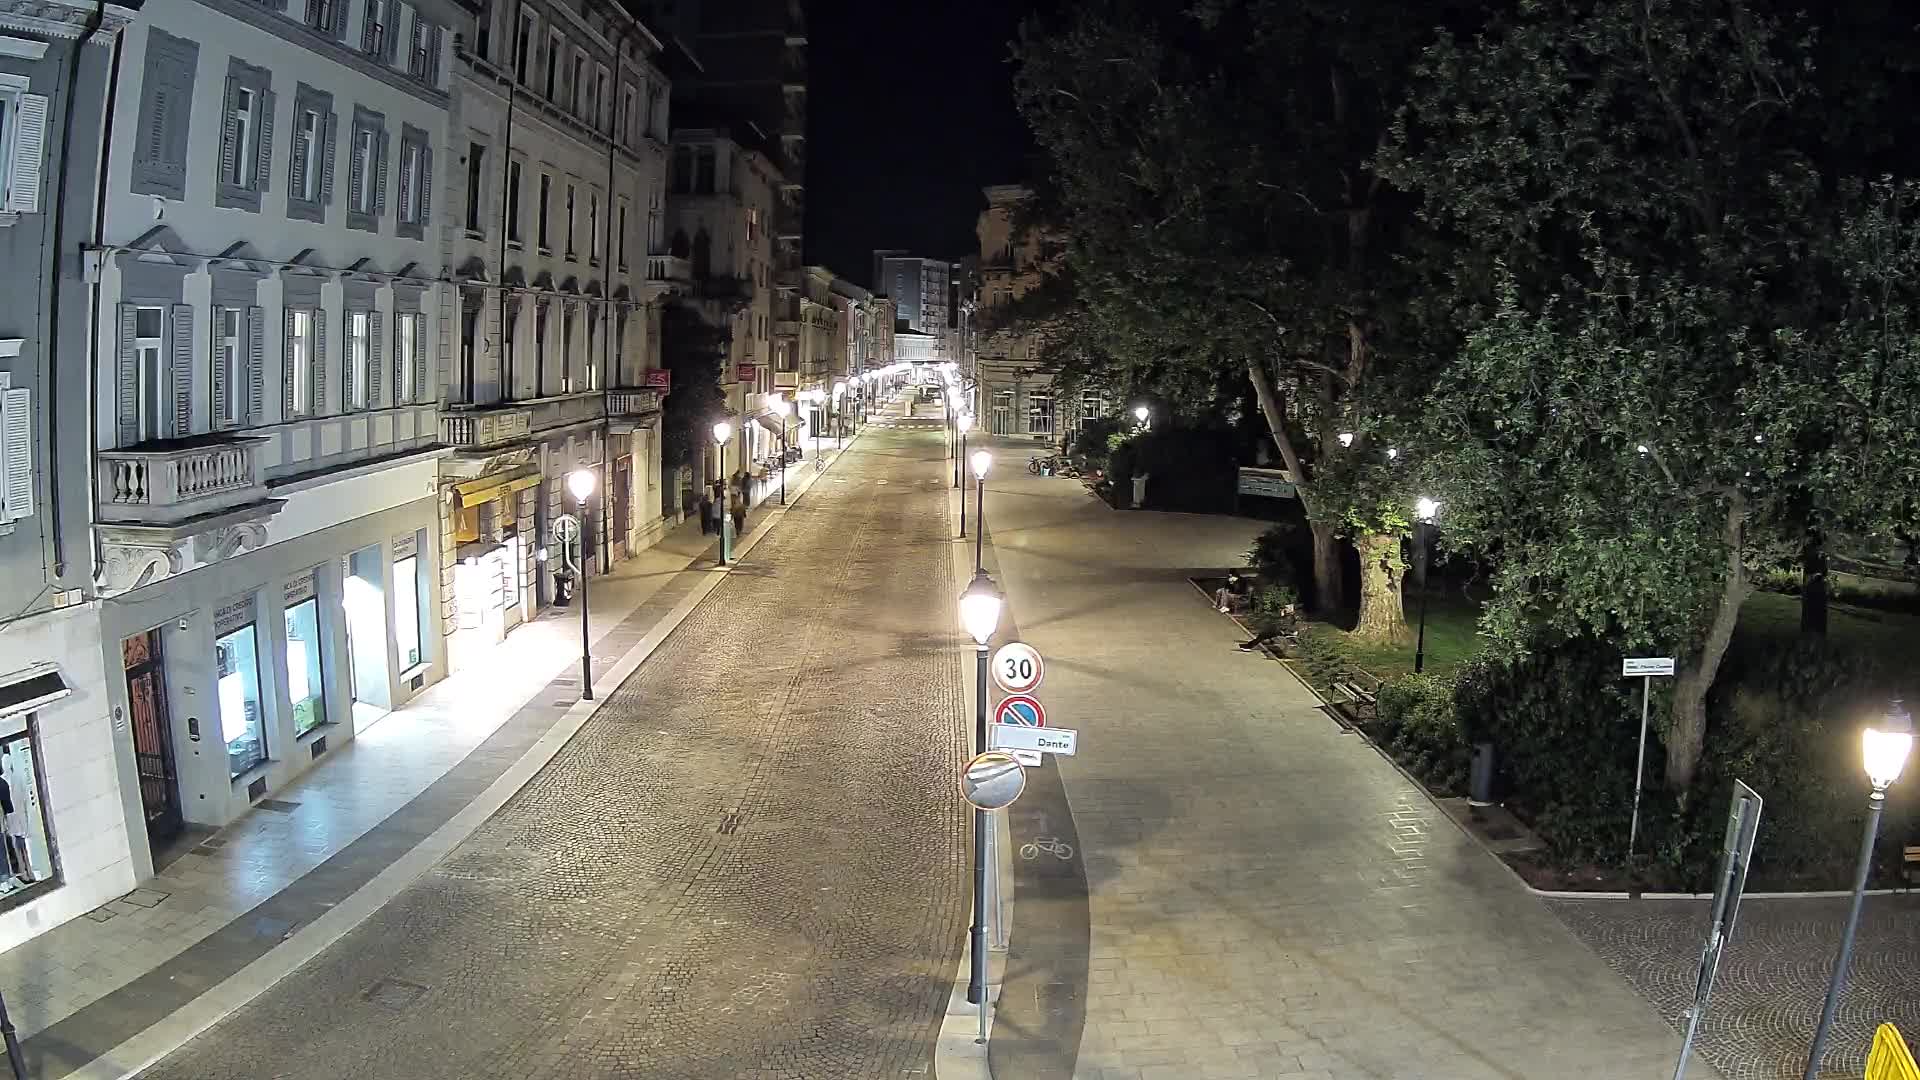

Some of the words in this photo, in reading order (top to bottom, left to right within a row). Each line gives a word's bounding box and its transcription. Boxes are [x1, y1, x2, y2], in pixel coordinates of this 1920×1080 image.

[214, 612, 243, 628] OPERATIVO
[1006, 658, 1032, 679] 30
[1038, 738, 1069, 749] Dante
